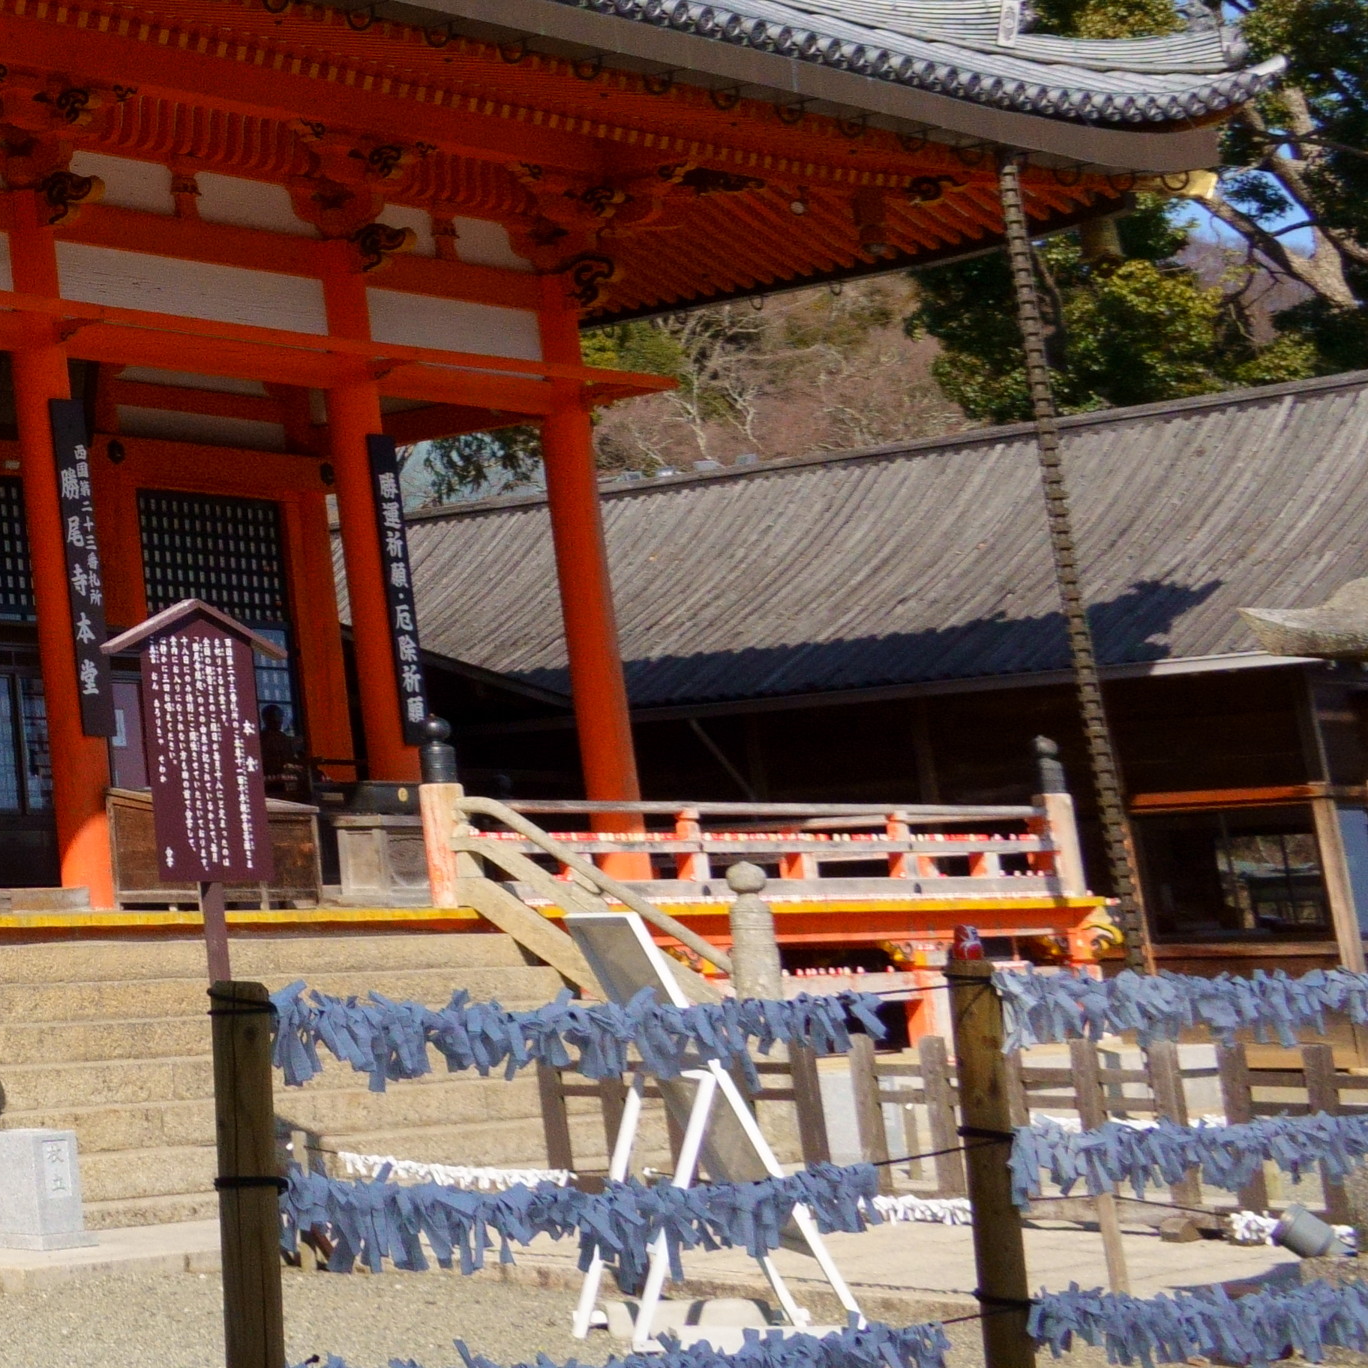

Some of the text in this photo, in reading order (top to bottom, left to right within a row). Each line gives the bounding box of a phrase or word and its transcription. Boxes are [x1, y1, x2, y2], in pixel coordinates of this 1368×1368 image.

[60, 466, 101, 697] 勝尾寺本堂
[73, 444, 103, 607] 西国第二十三番札所
[377, 472, 426, 724] 勝運祈願・厄除祈願
[241, 719, 255, 771] 本堂
